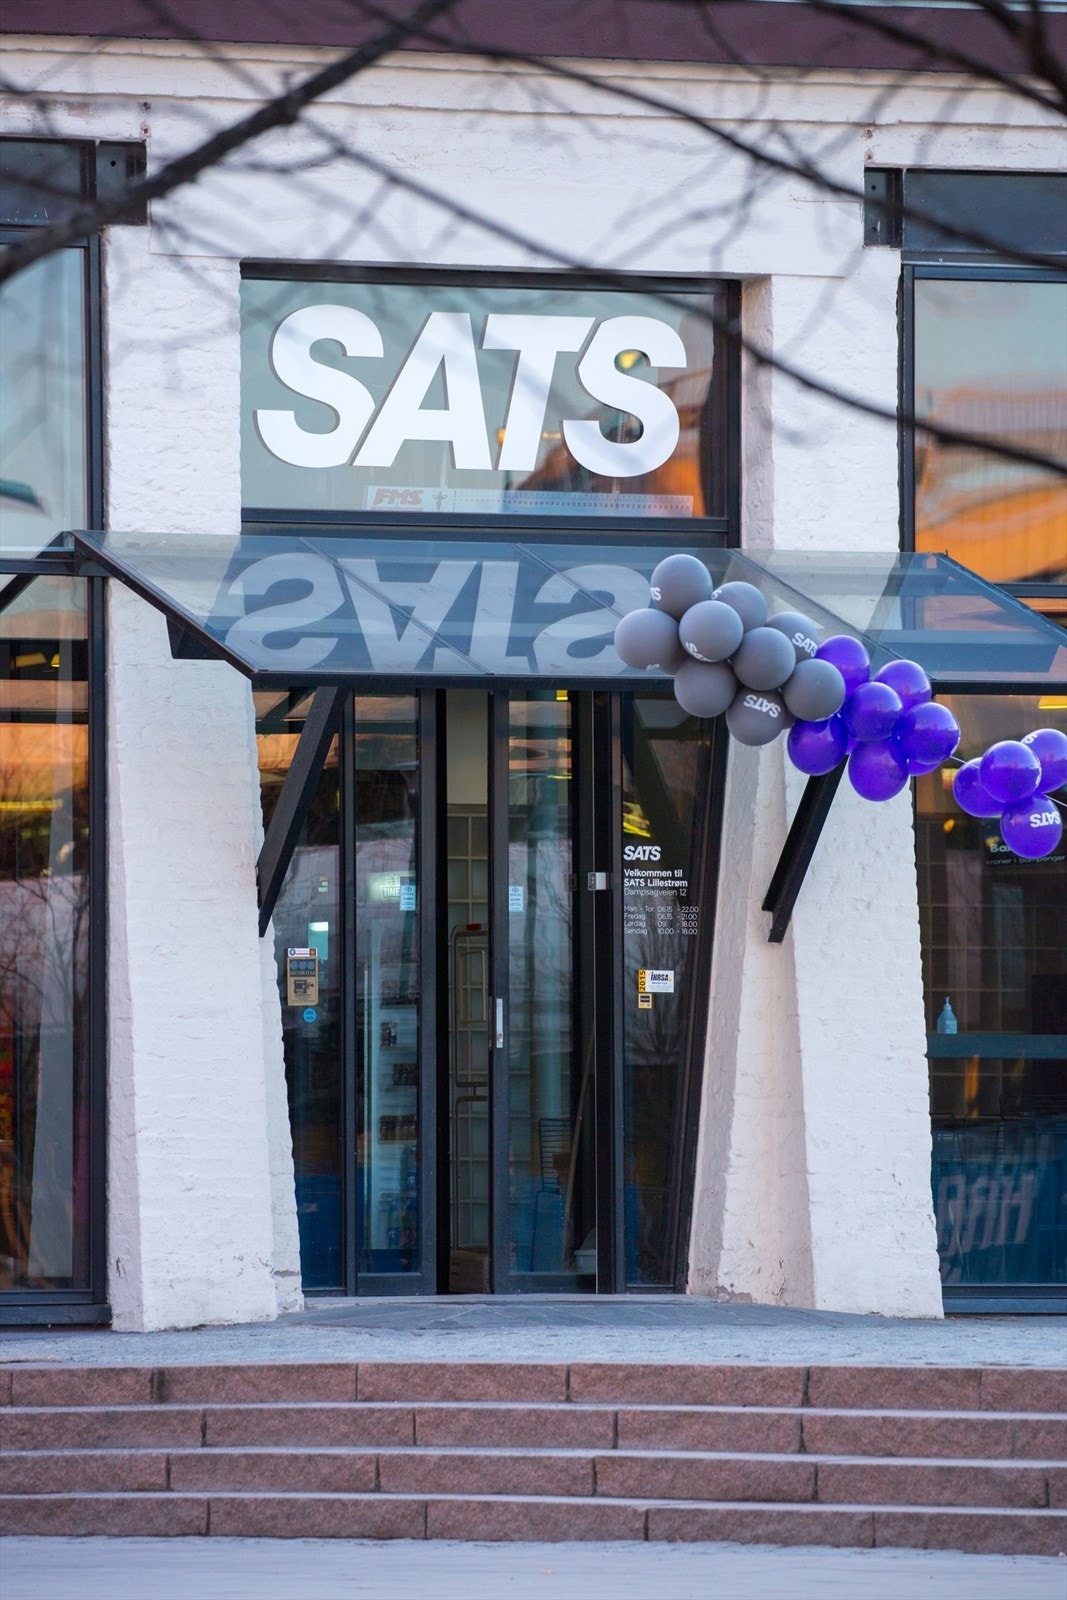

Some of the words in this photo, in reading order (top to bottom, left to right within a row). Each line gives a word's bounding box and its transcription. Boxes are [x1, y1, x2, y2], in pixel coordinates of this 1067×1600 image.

[255, 304, 687, 477] SATS
[792, 633, 818, 657] SATS
[743, 694, 781, 718] SATS
[1030, 811, 1061, 828] SATS
[623, 845, 661, 861] SATS
[623, 869, 672, 877] Velkommen
[674, 869, 683, 877] til
[624, 879, 645, 887] SATS
[647, 879, 688, 887] Lillestrøm
[383, 887, 400, 897] TINE
[624, 888, 677, 897] Dampsagveien
[679, 888, 687, 896] 12
